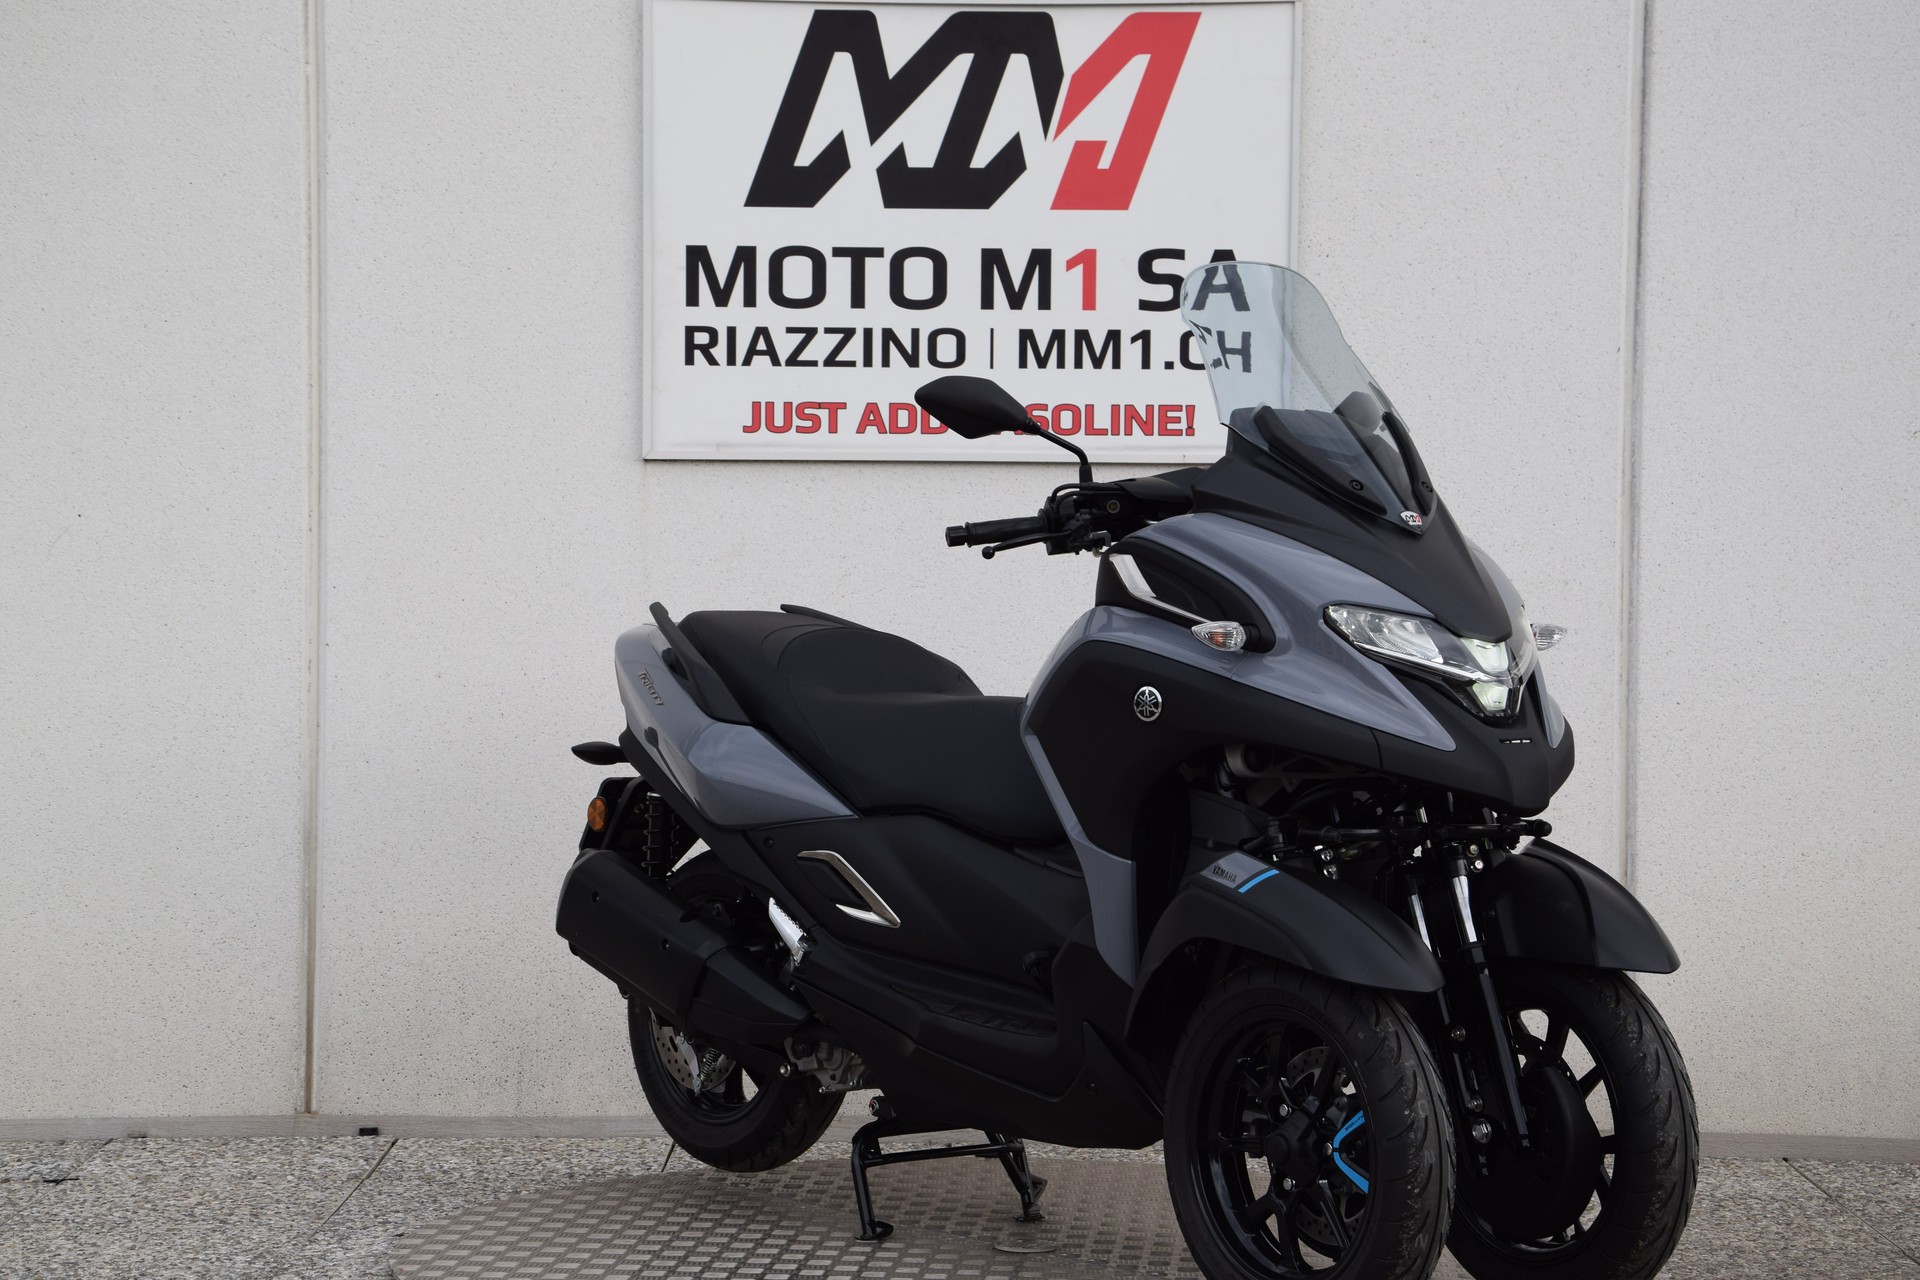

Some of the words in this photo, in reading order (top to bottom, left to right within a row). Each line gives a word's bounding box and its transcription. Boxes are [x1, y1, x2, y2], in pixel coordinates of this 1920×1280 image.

[686, 245, 947, 310] MOTO
[981, 248, 1096, 310] M1
[1137, 247, 1251, 312] SA
[685, 326, 966, 368] RIAZZINO
[1019, 328, 1252, 373] MM1.CH
[743, 401, 847, 434] JUST
[1213, 865, 1237, 883] YAMAHA
